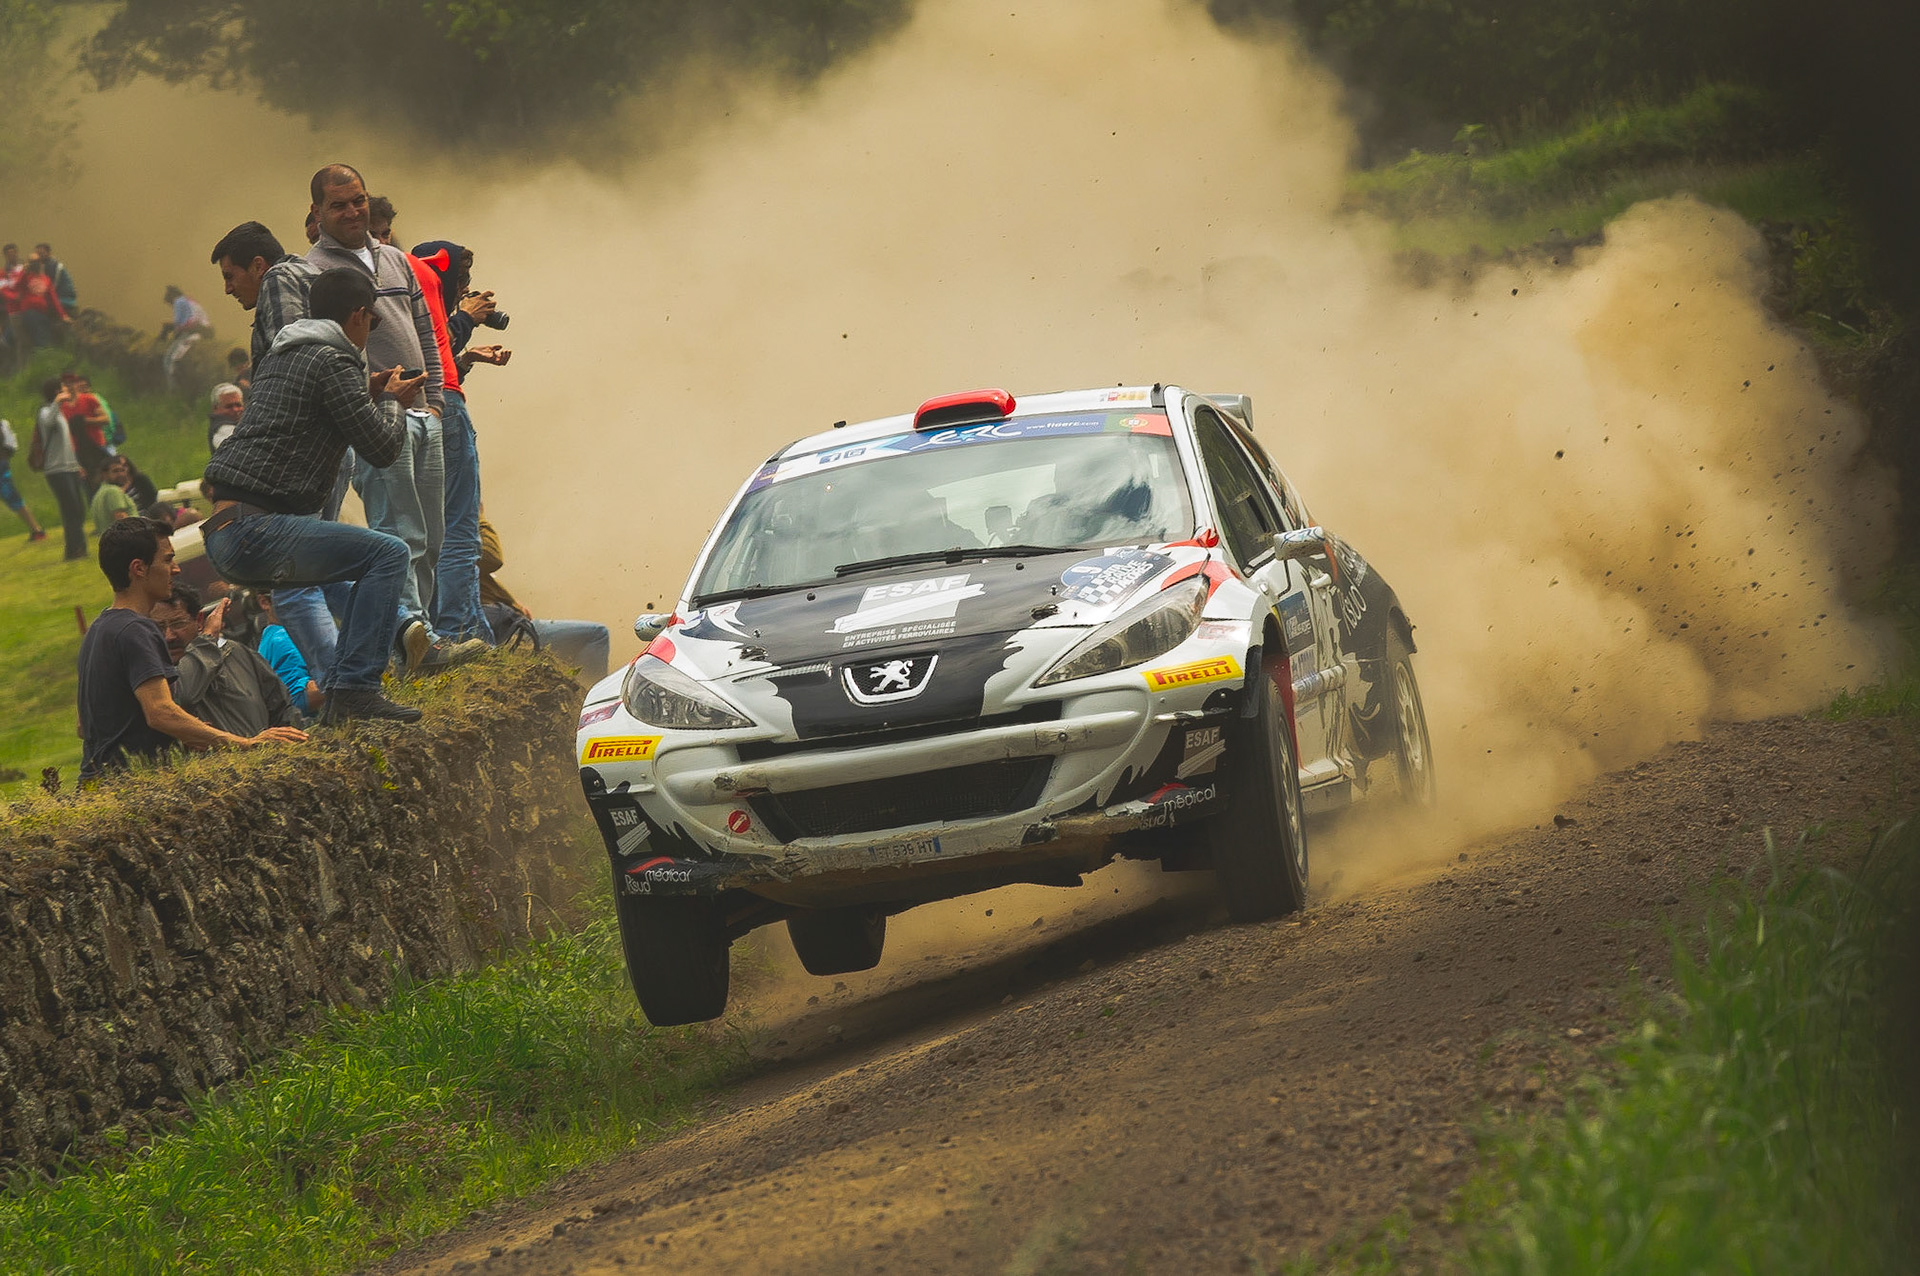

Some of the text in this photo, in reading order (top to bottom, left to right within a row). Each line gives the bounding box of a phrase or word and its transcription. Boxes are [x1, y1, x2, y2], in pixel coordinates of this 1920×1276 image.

[871, 574, 970, 600] ESAF
[842, 640, 854, 649] EN
[897, 628, 955, 640] FERROVIAIRES
[844, 620, 957, 642] ENTREPRISE SPÉCIALISÉE
[1152, 660, 1232, 685] PIRELLI
[588, 739, 653, 759] PIRELLI
[1185, 727, 1220, 749] ESAF
[609, 809, 639, 827] ESAF
